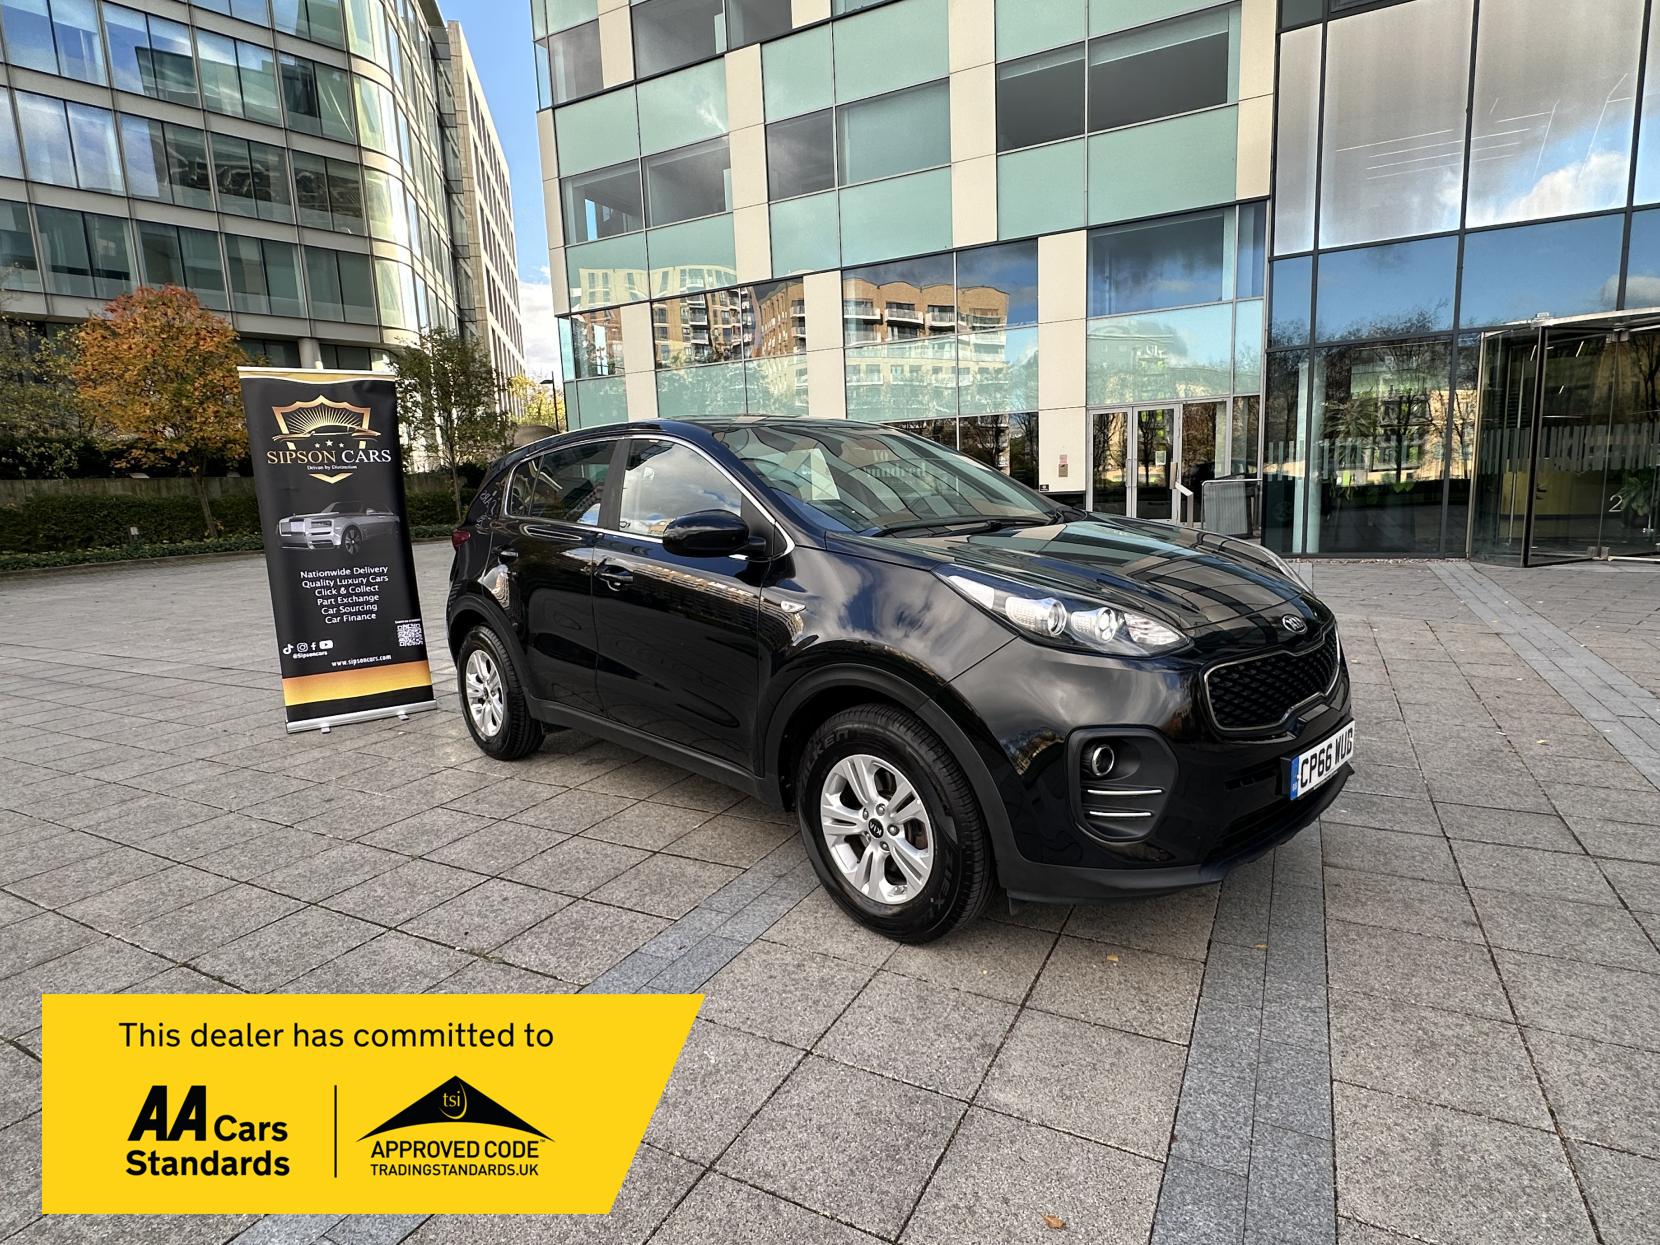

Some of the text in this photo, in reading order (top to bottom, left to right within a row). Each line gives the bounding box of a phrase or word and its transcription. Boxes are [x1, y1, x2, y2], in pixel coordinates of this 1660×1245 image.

[267, 449, 392, 464] SIPSON CARS
[1608, 494, 1623, 513] 2
[300, 566, 388, 578] Nationwide Delivery
[302, 579, 335, 588] Quality
[337, 577, 367, 585] Luxury
[315, 588, 338, 596] Click
[349, 585, 379, 593] Collect
[317, 594, 379, 606] Part Exchange
[321, 603, 378, 615] Car Sourcing
[325, 613, 377, 624] Car Finance
[331, 655, 392, 667] www.sipsoncars.com
[1301, 743, 1332, 788] CP66
